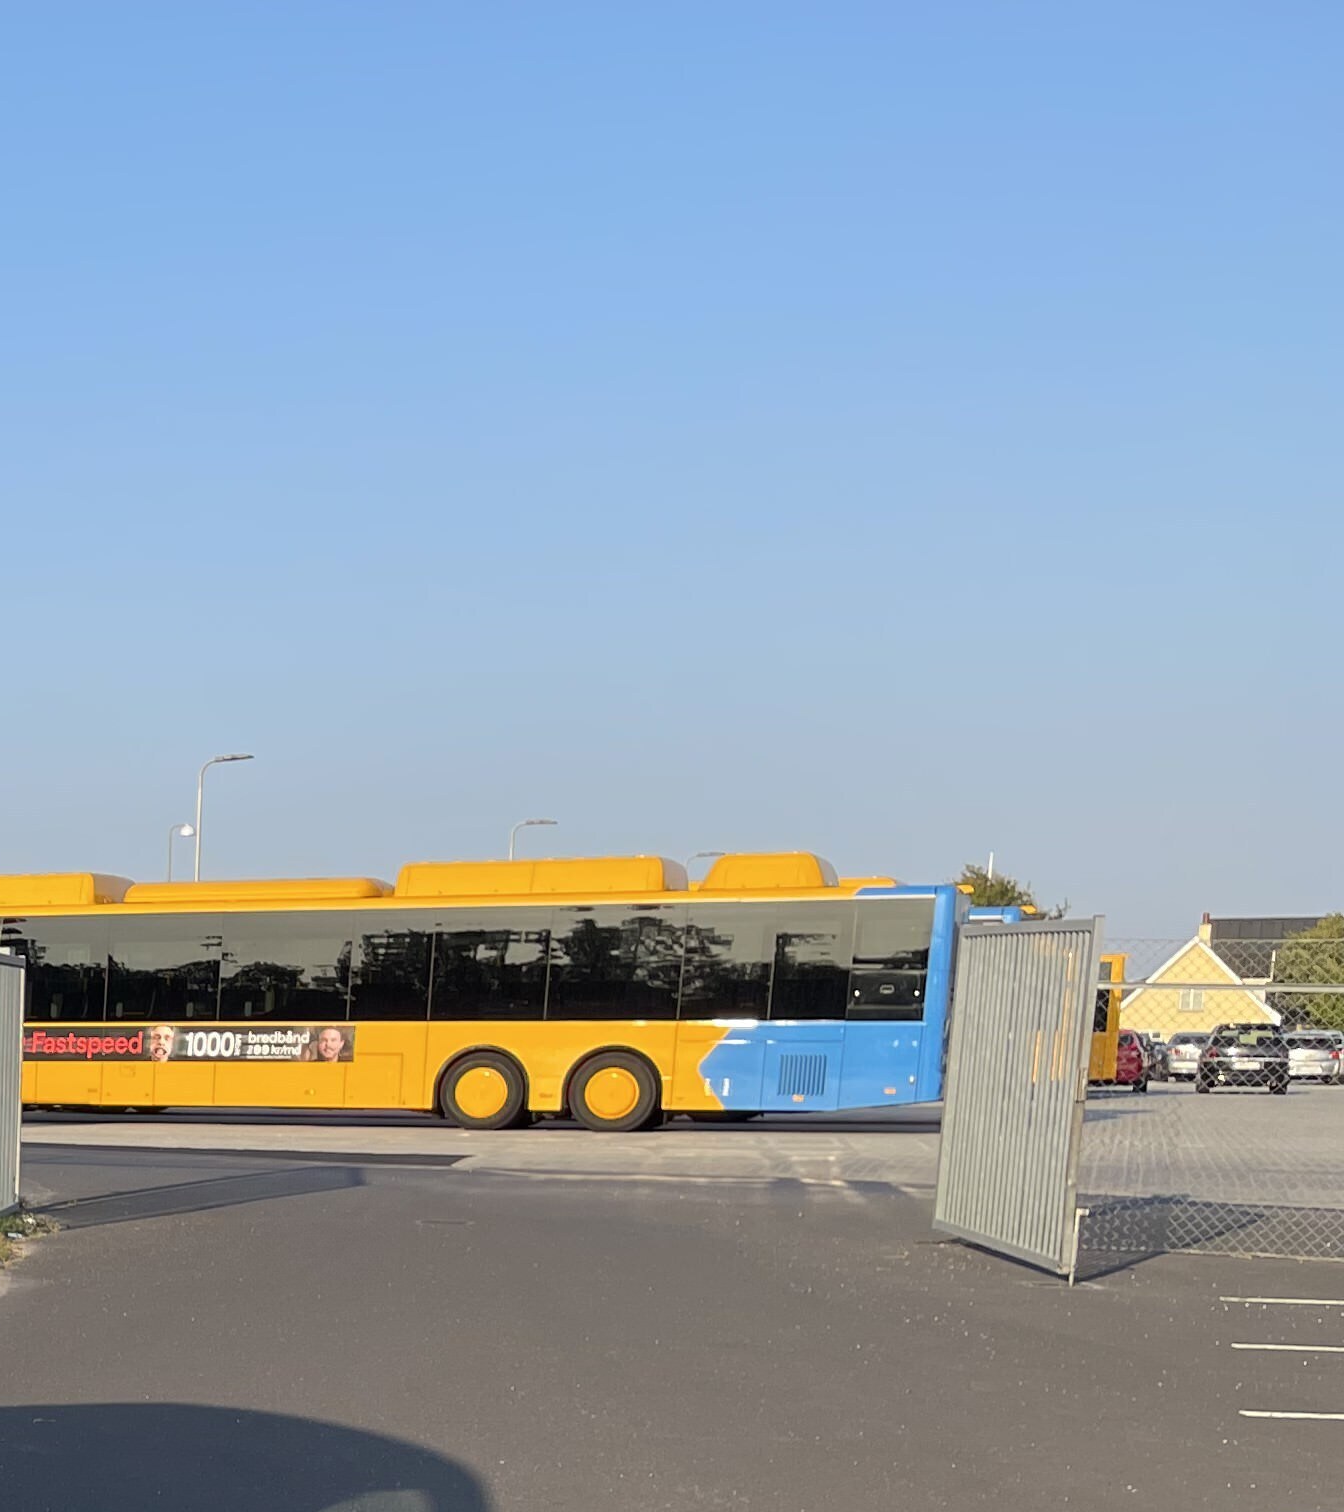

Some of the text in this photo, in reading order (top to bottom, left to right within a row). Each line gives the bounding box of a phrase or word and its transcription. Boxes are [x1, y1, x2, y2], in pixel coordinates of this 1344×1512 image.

[32, 1031, 143, 1059] Fastspeed
[185, 1031, 234, 1057] 1000
[247, 1030, 310, 1044] bredbånd
